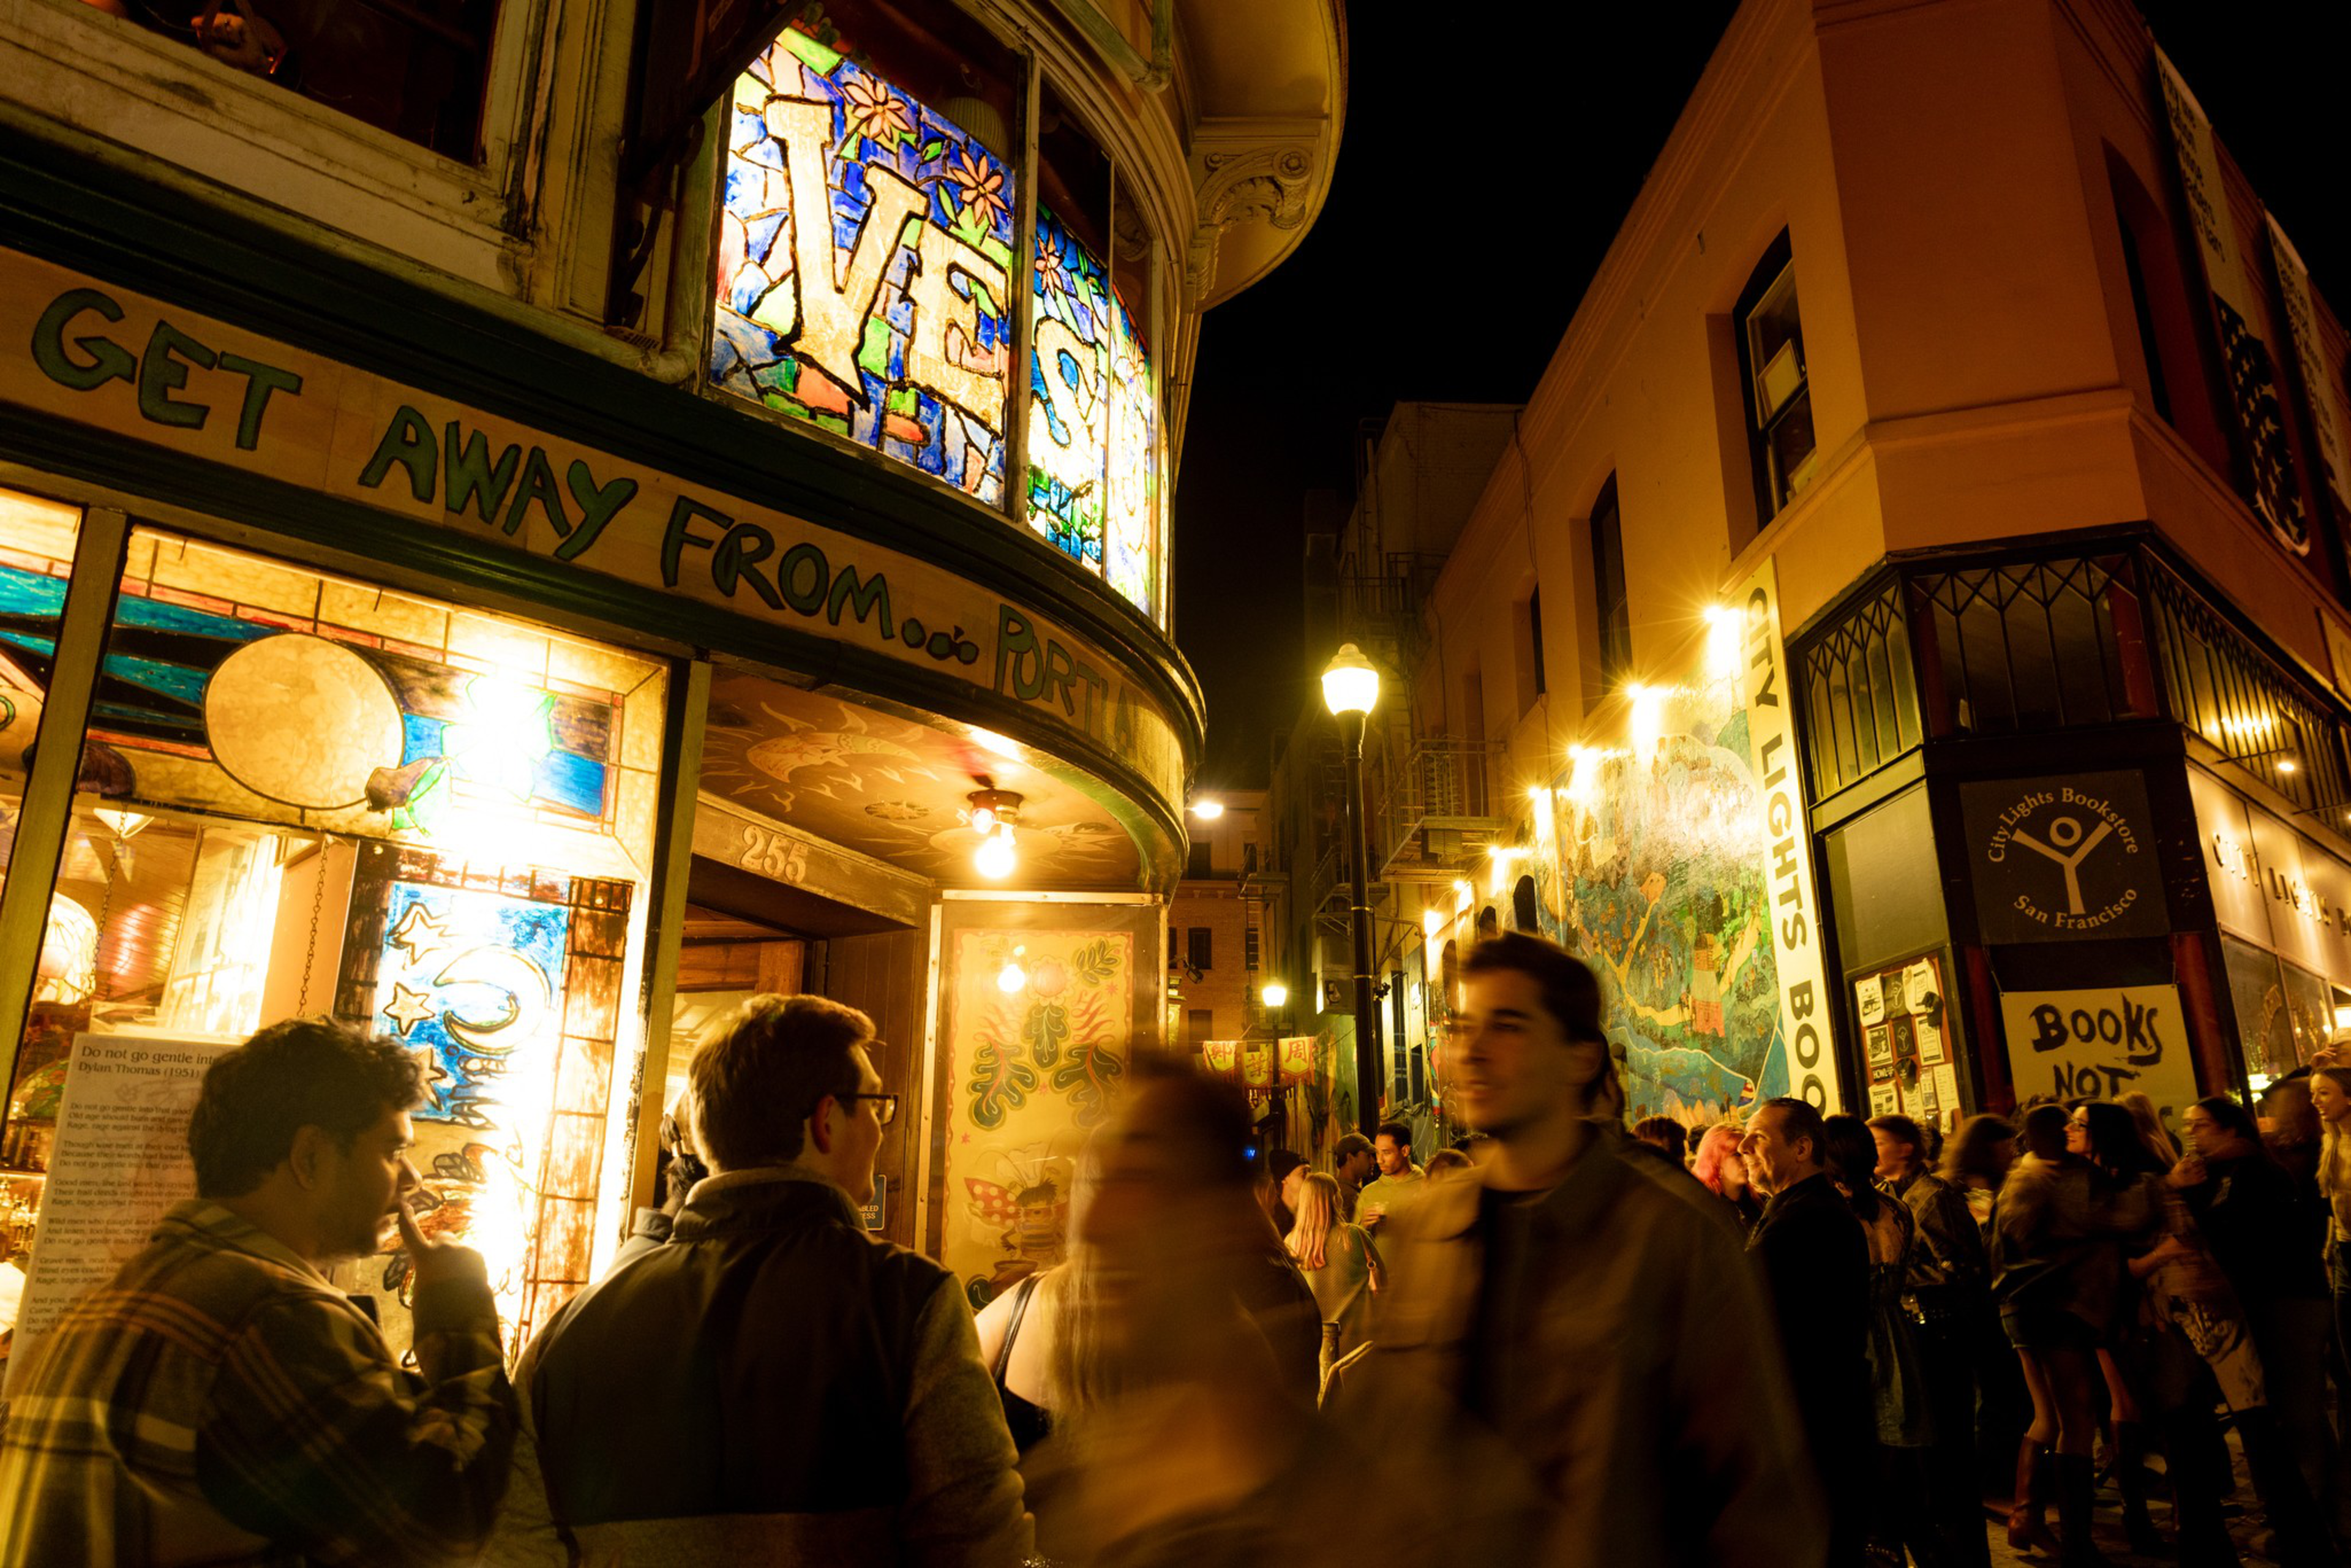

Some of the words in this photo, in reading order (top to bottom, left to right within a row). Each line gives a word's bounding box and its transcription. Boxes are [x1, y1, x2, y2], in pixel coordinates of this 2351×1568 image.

[31, 288, 303, 451] GET
[358, 405, 639, 561] AWAY
[1747, 587, 1779, 708] CITY
[1999, 792, 2055, 827] Lights
[2061, 787, 2139, 854] Bookstore
[740, 825, 809, 883] 255
[1761, 732, 1807, 951] LIGHTS
[1988, 825, 2012, 863] City
[2014, 895, 2049, 923] San
[2054, 888, 2137, 929] Francisco
[2028, 992, 2163, 1067] BOOKS
[78, 1060, 111, 1074] Dylan
[114, 1063, 161, 1076] Thomas
[163, 1067, 200, 1079] (1951)
[82, 1046, 101, 1058] Do
[105, 1048, 127, 1060] not
[130, 1051, 149, 1063] go
[151, 1051, 193, 1065] gentle
[196, 1054, 213, 1065] int
[1284, 1040, 1308, 1065] 周
[2053, 1060, 2142, 1098] NOT
